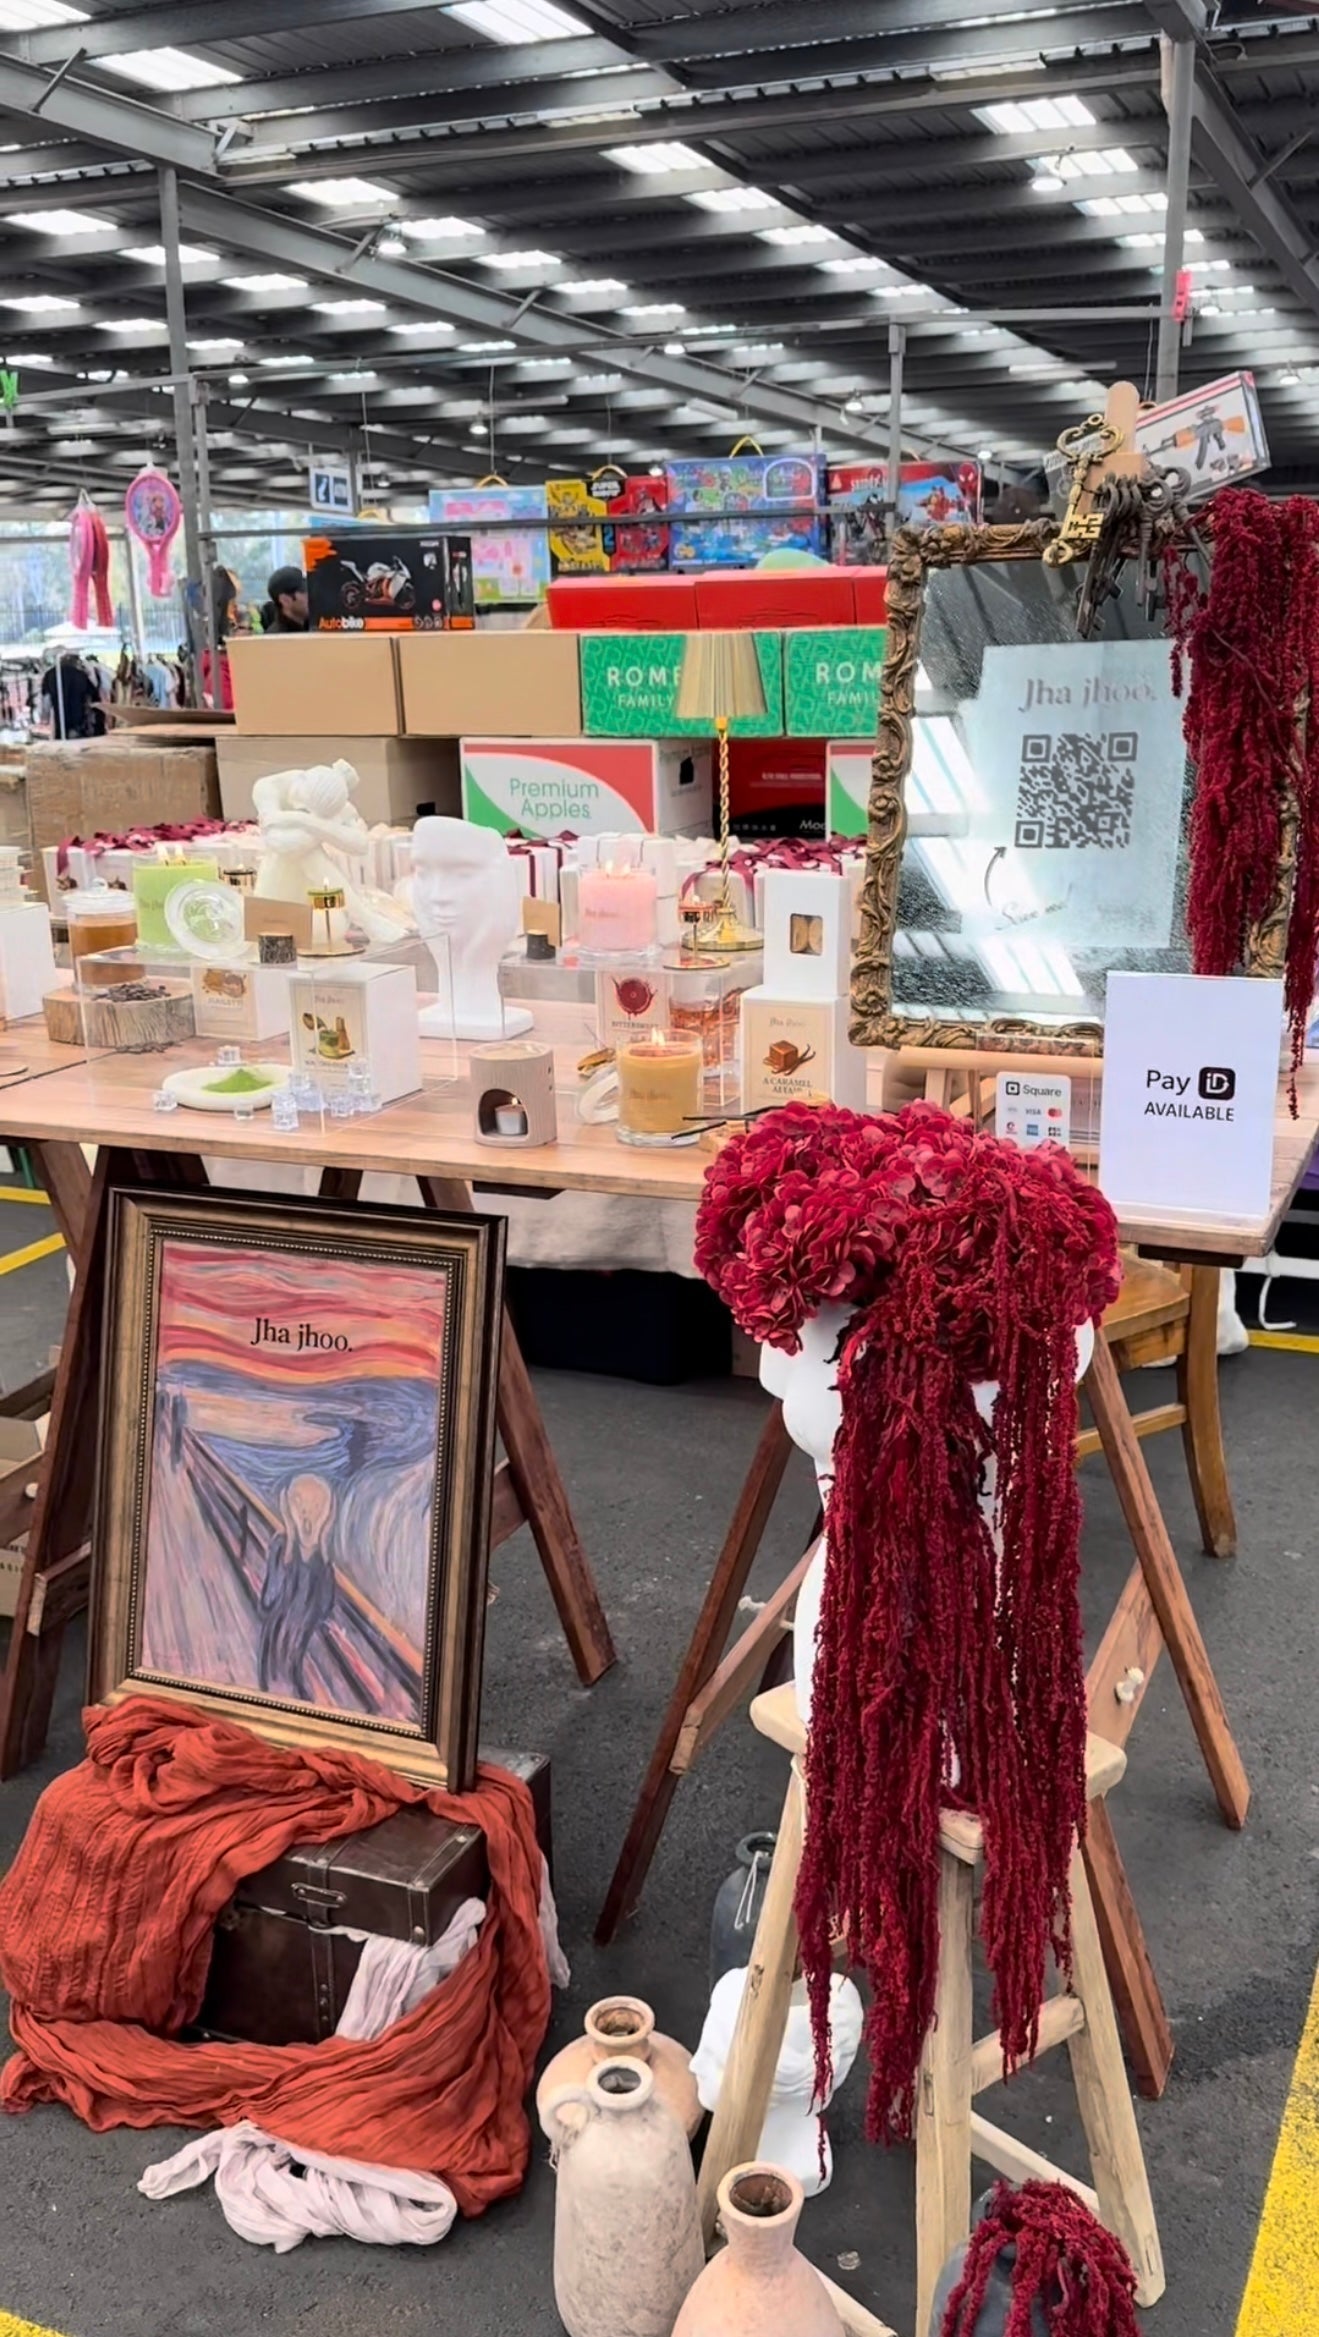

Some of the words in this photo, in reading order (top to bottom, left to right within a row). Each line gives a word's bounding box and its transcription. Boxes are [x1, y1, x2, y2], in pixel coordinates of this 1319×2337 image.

[319, 616, 364, 629] Autobike
[1018, 679, 1071, 712] Jha
[509, 778, 599, 798] Premium
[521, 798, 590, 820] Apples
[1022, 1084, 1062, 1097] Square
[1146, 1069, 1191, 1095] Pay
[1144, 1101, 1234, 1122] AVAILABLE
[250, 1317, 290, 1345] Jha
[297, 1323, 353, 1352] jhoo.
